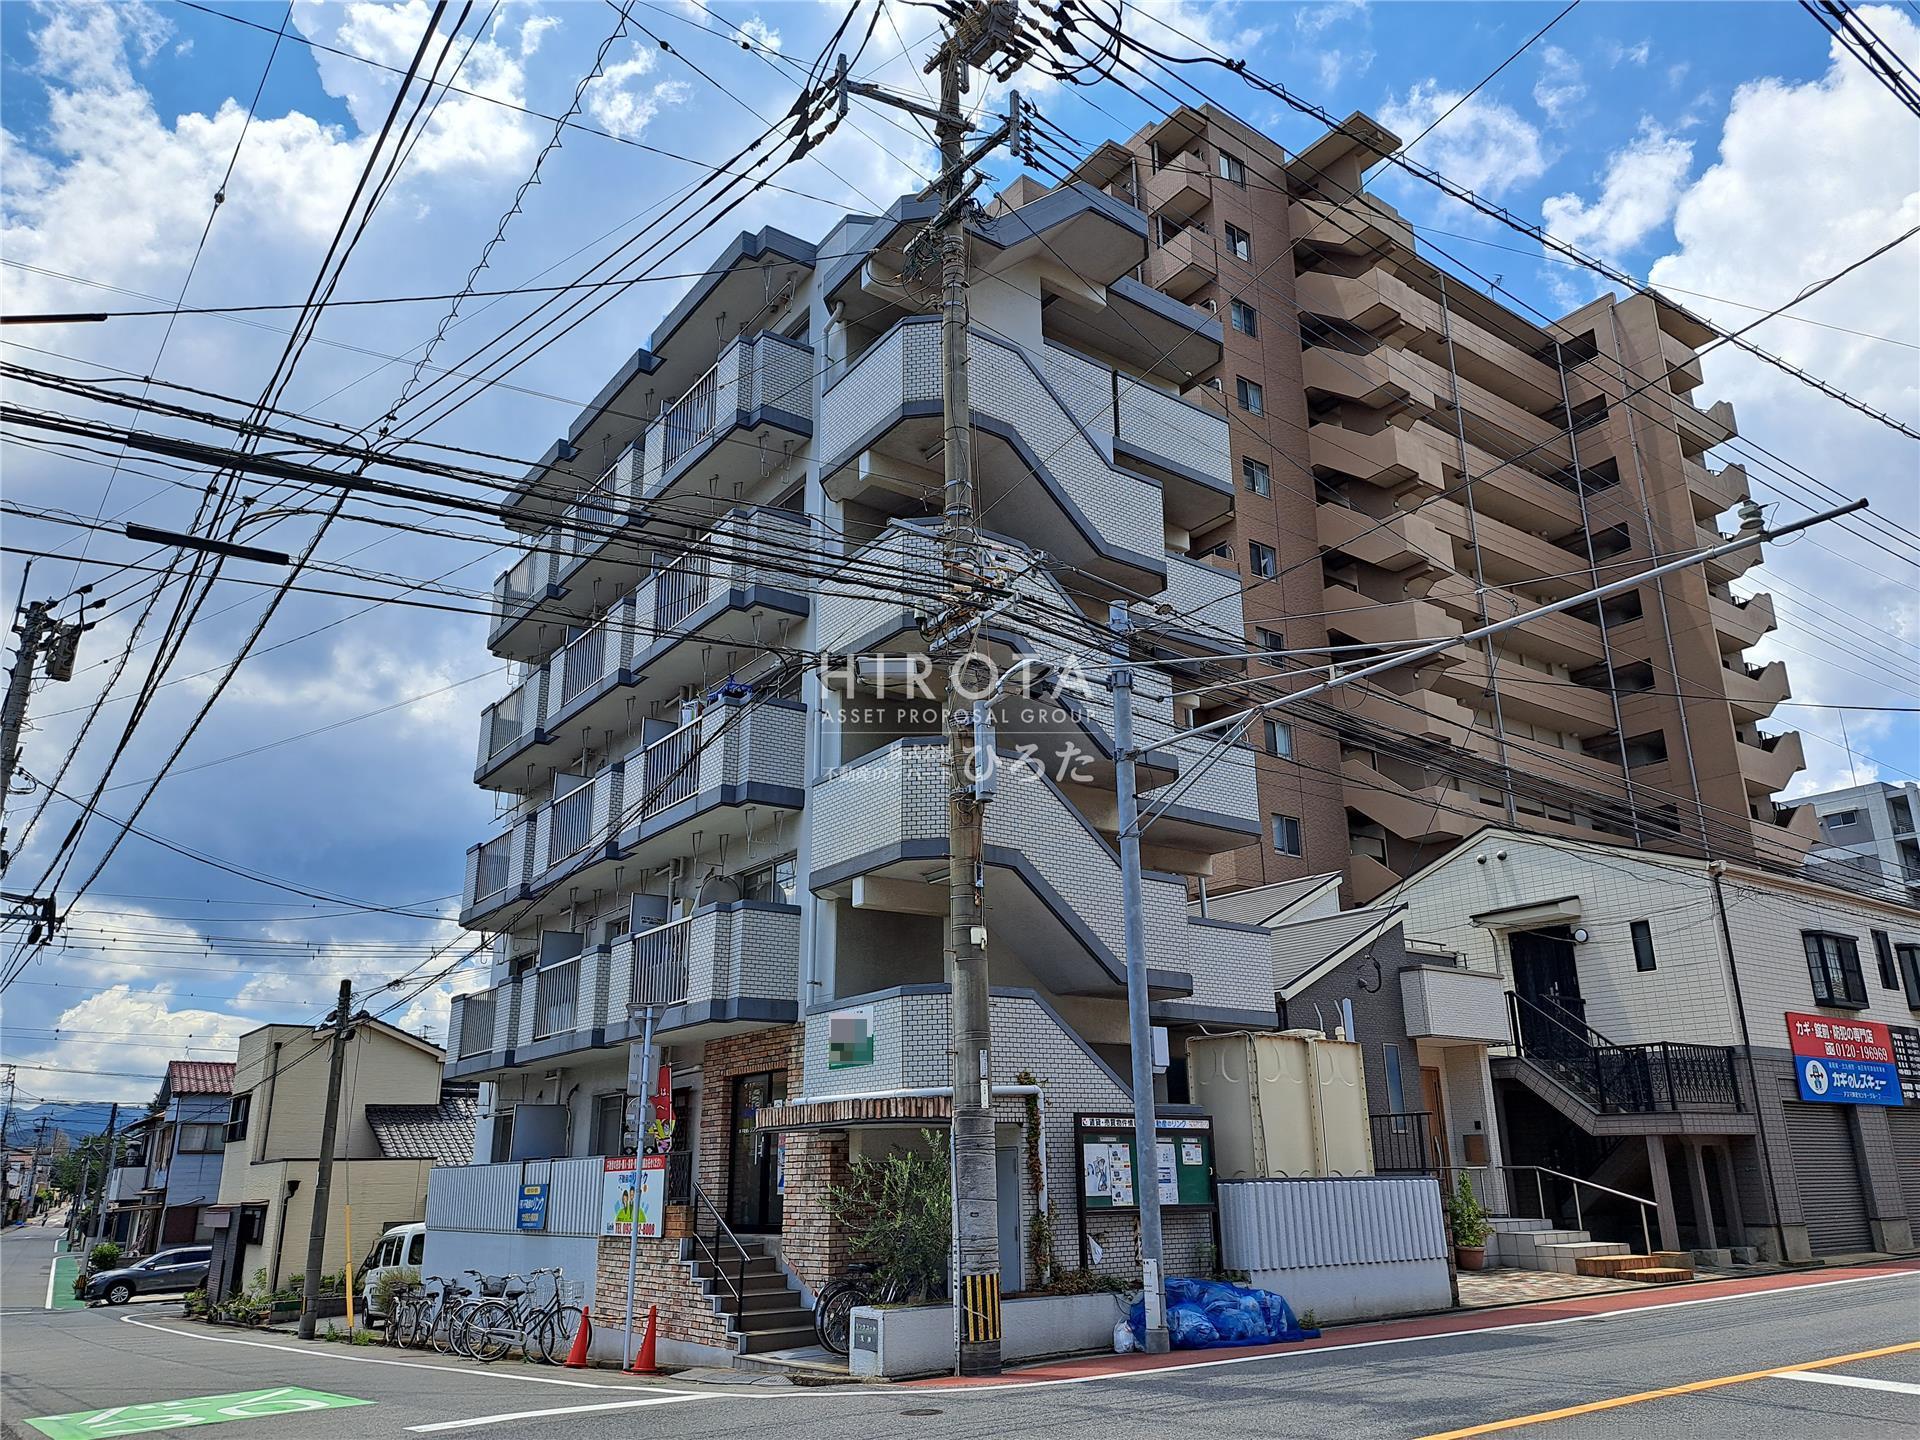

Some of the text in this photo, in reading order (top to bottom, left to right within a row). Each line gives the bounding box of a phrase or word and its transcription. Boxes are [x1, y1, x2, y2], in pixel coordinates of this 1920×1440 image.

[1835, 1043, 1888, 1061] 0120-196969
[1832, 1072, 1887, 1090] カギのレスキュー
[1089, 1118, 1136, 1127] 賃貸・売買物件情
[1156, 1119, 1186, 1128] 動産のリンク
